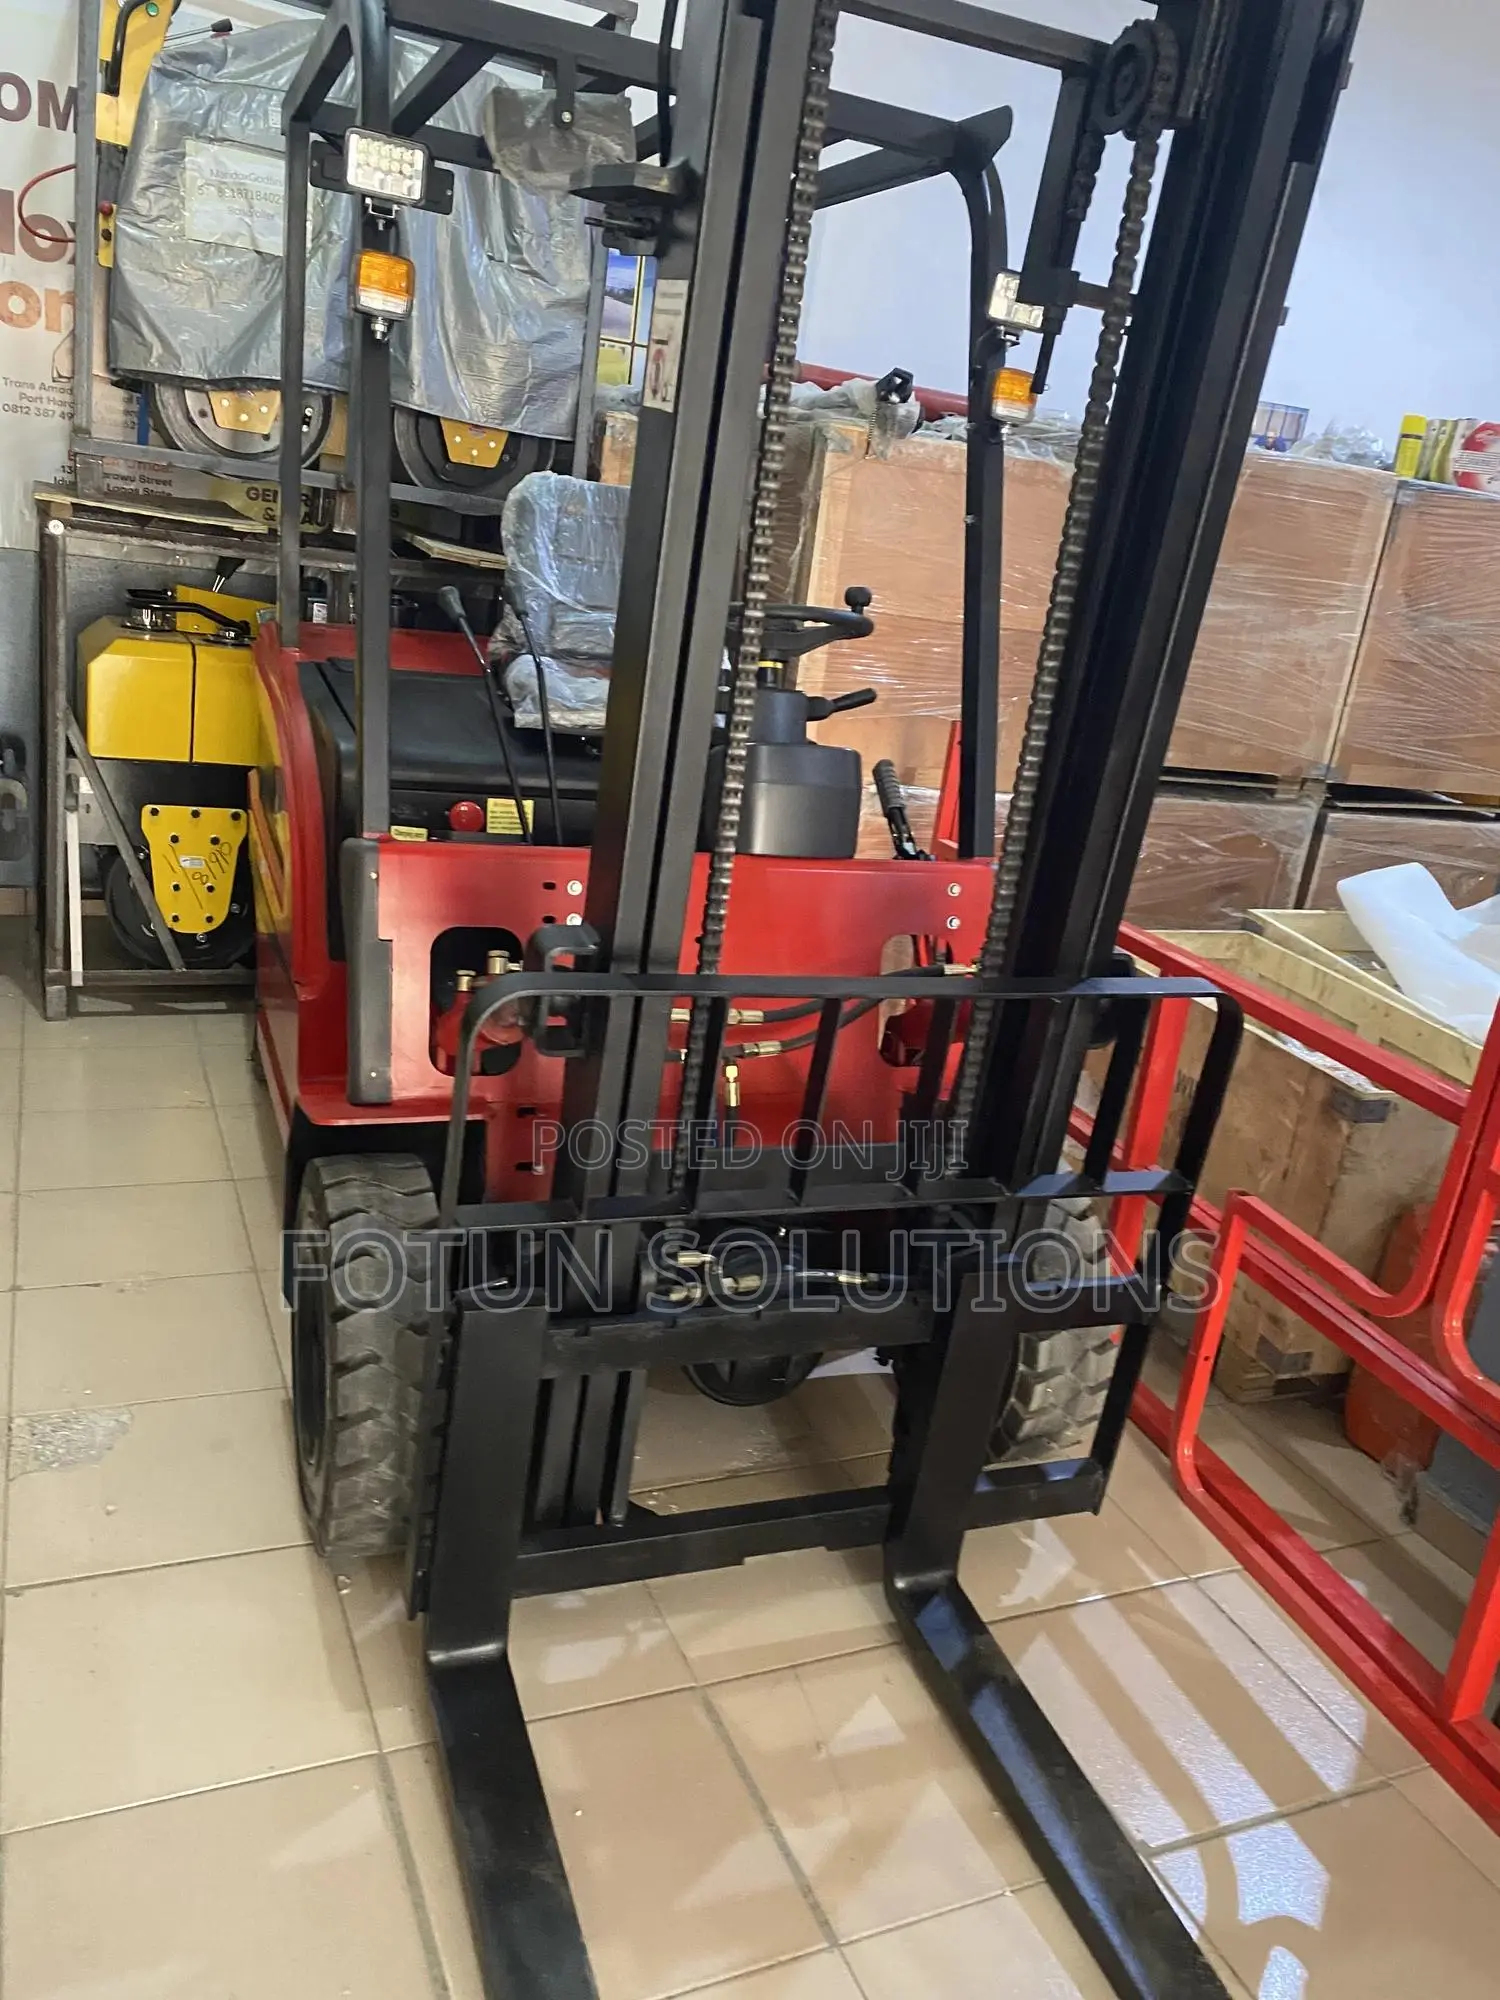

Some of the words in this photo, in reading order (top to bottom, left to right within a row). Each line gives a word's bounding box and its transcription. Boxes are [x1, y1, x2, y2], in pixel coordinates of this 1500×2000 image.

[19, 391, 44, 405] Port
[2, 402, 32, 416] 0812
[138, 473, 173, 487] Street
